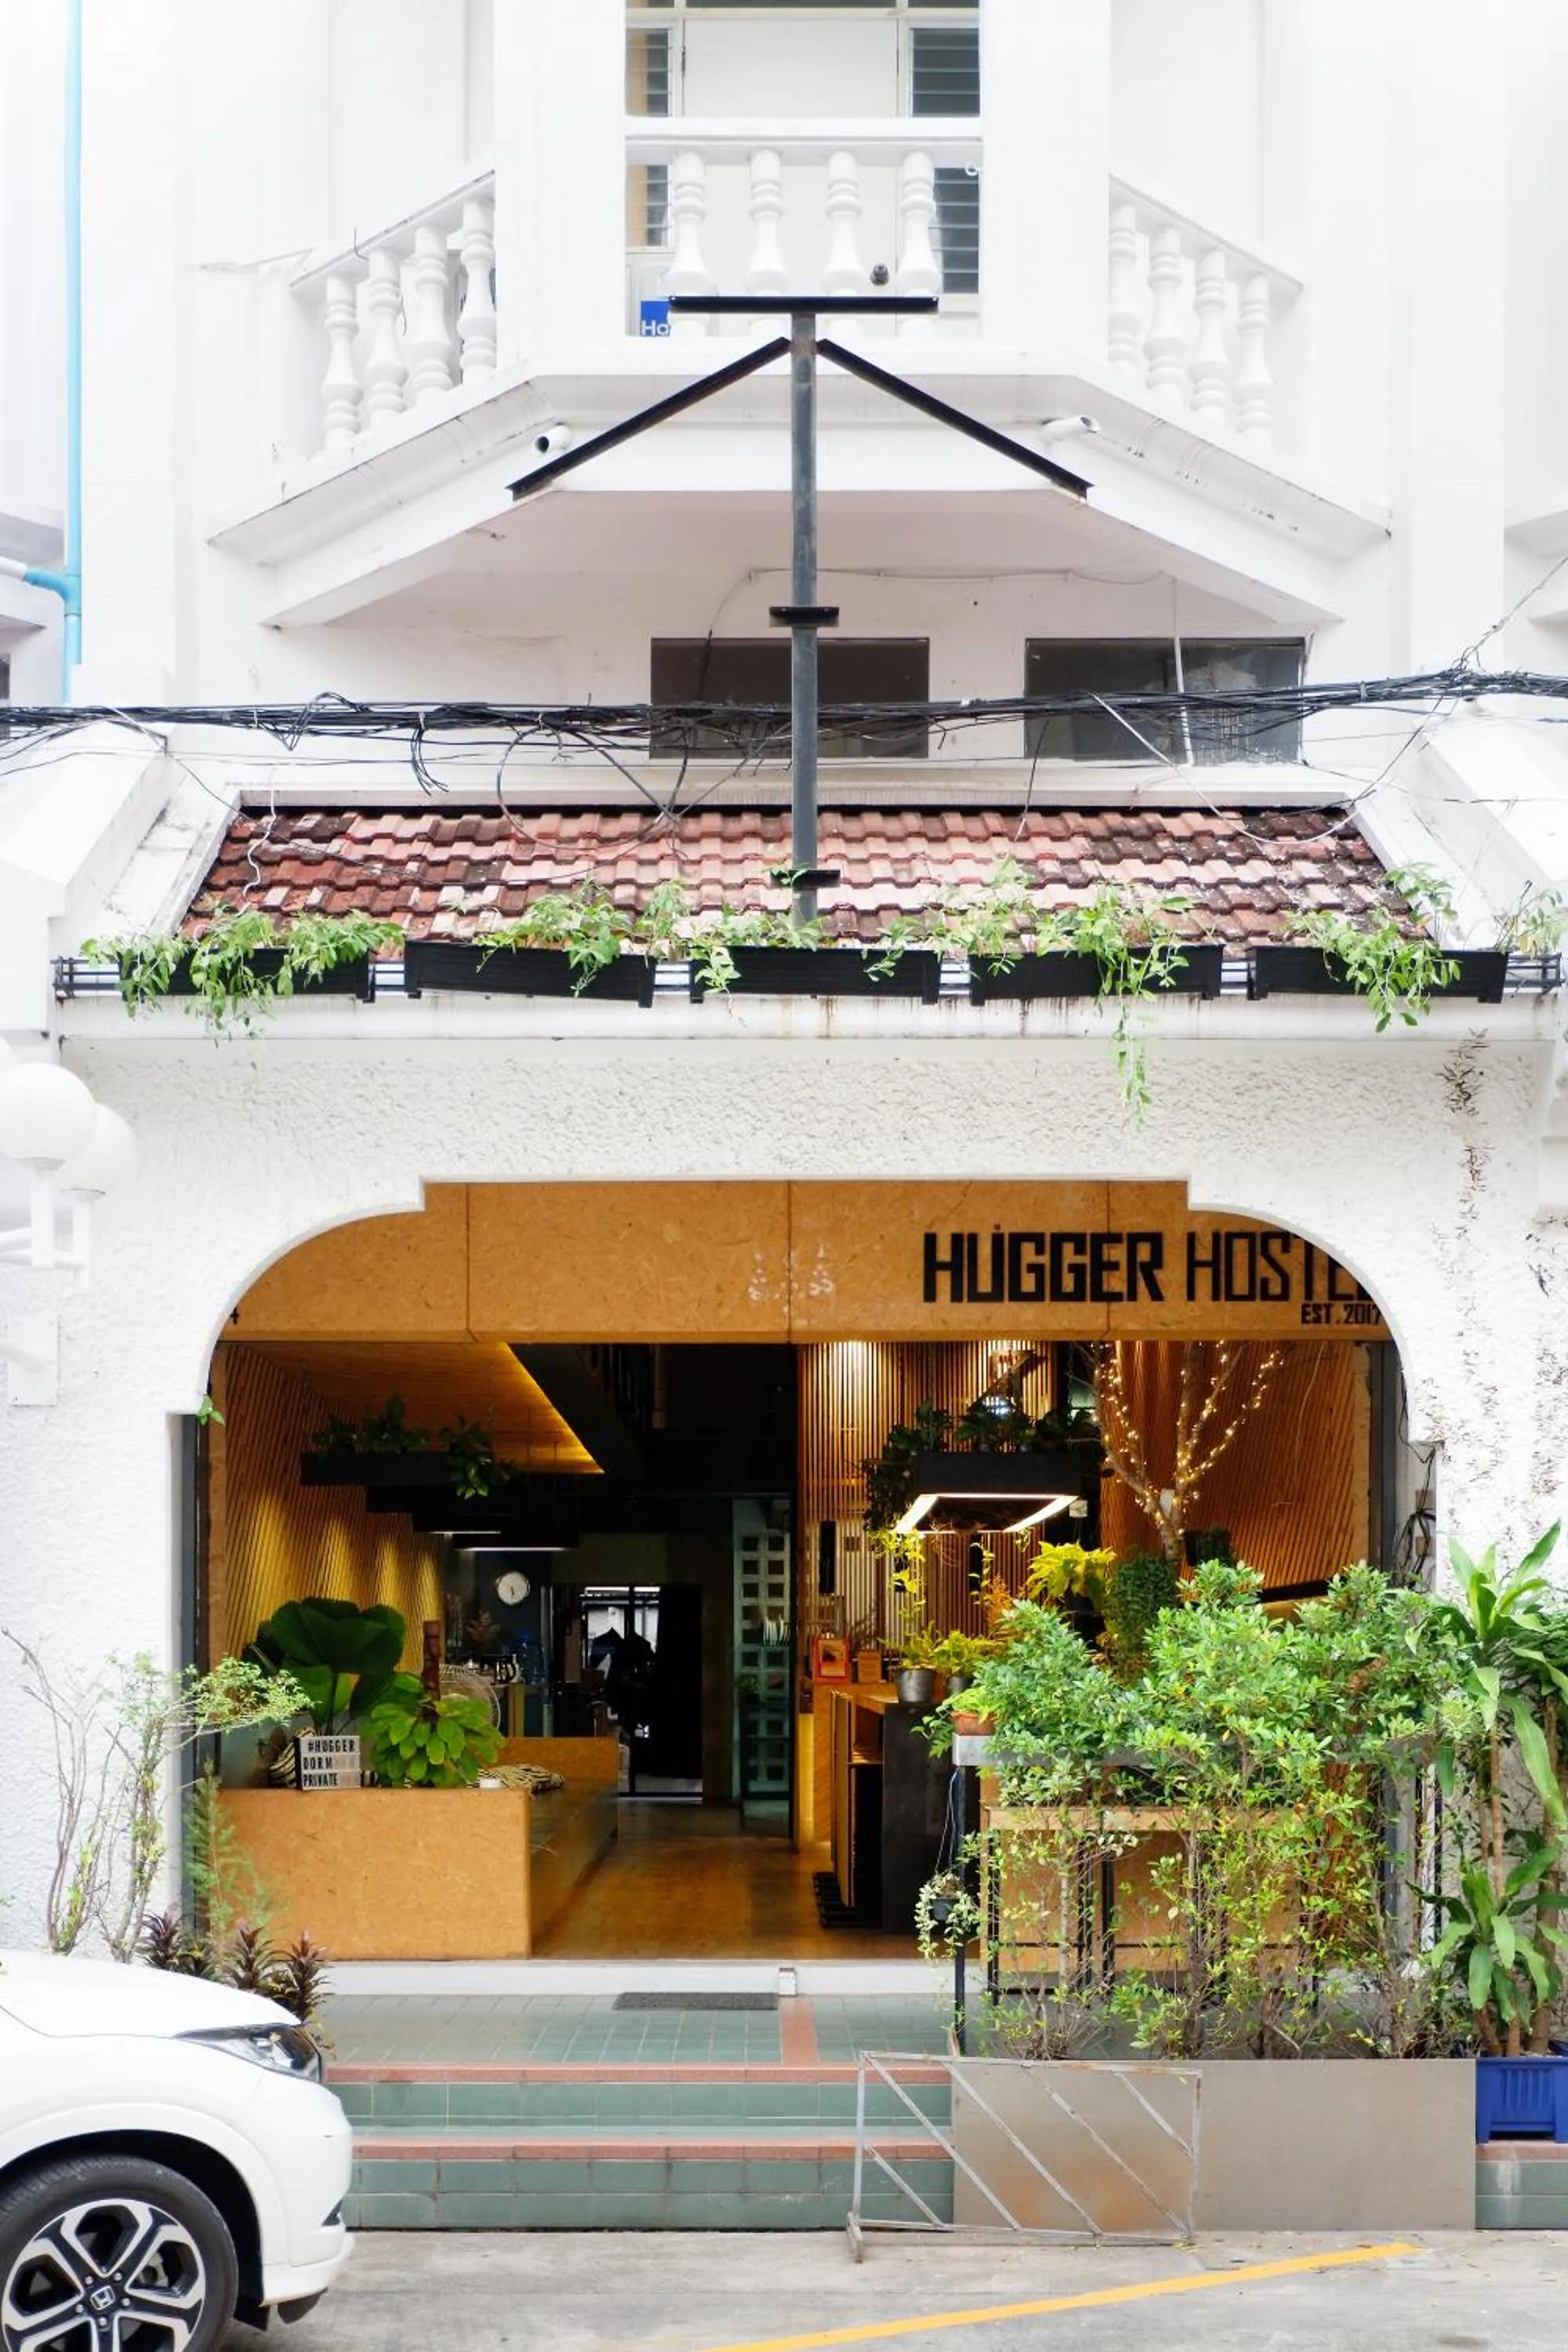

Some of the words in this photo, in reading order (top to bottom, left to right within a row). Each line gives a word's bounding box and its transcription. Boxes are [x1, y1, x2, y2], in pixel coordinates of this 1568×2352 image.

[924, 1232, 1164, 1303] HUGGER
[1187, 1232, 1373, 1301] HOSTE
[303, 1757, 333, 1769] DORM
[303, 1773, 338, 1787] PRIVATE
